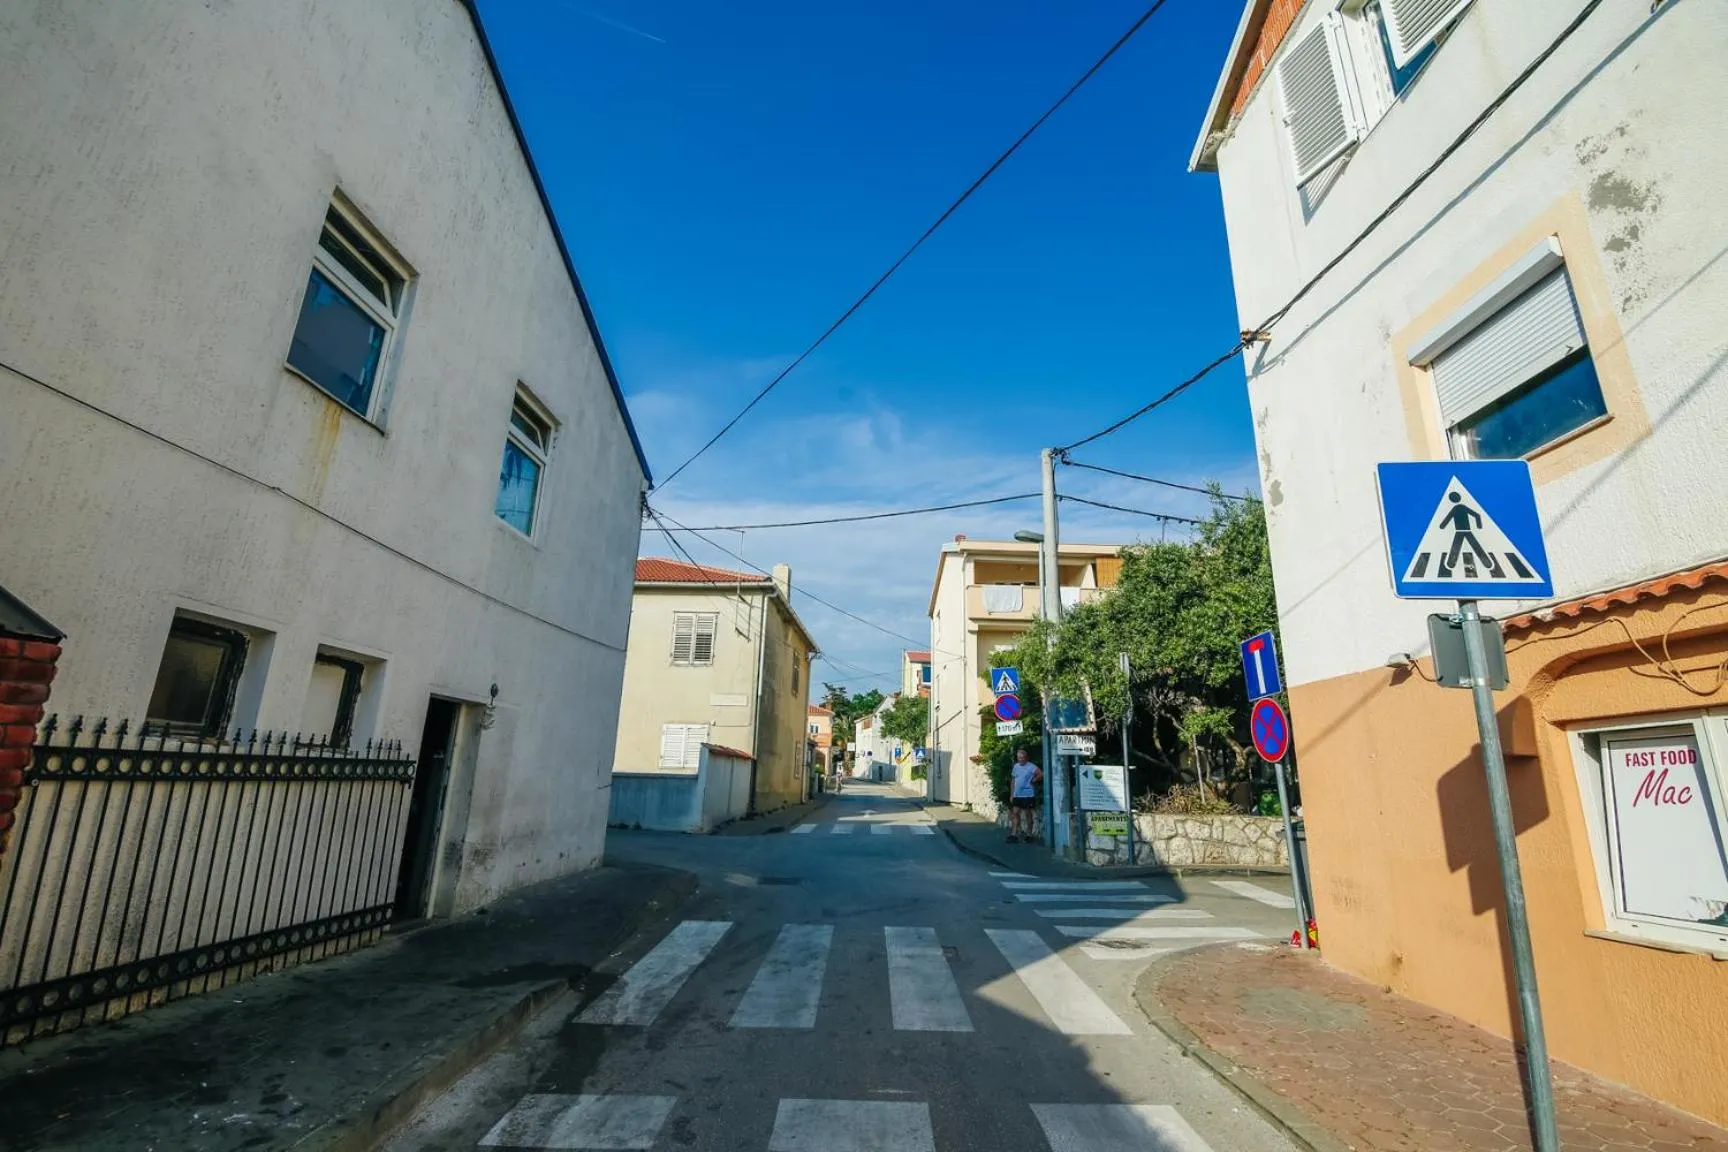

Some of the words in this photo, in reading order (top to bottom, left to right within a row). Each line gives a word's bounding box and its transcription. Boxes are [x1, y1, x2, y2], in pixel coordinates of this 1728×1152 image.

[1625, 752, 1655, 767] FAST
[1660, 750, 1697, 765] FOOD
[1633, 768, 1693, 807] Mac
